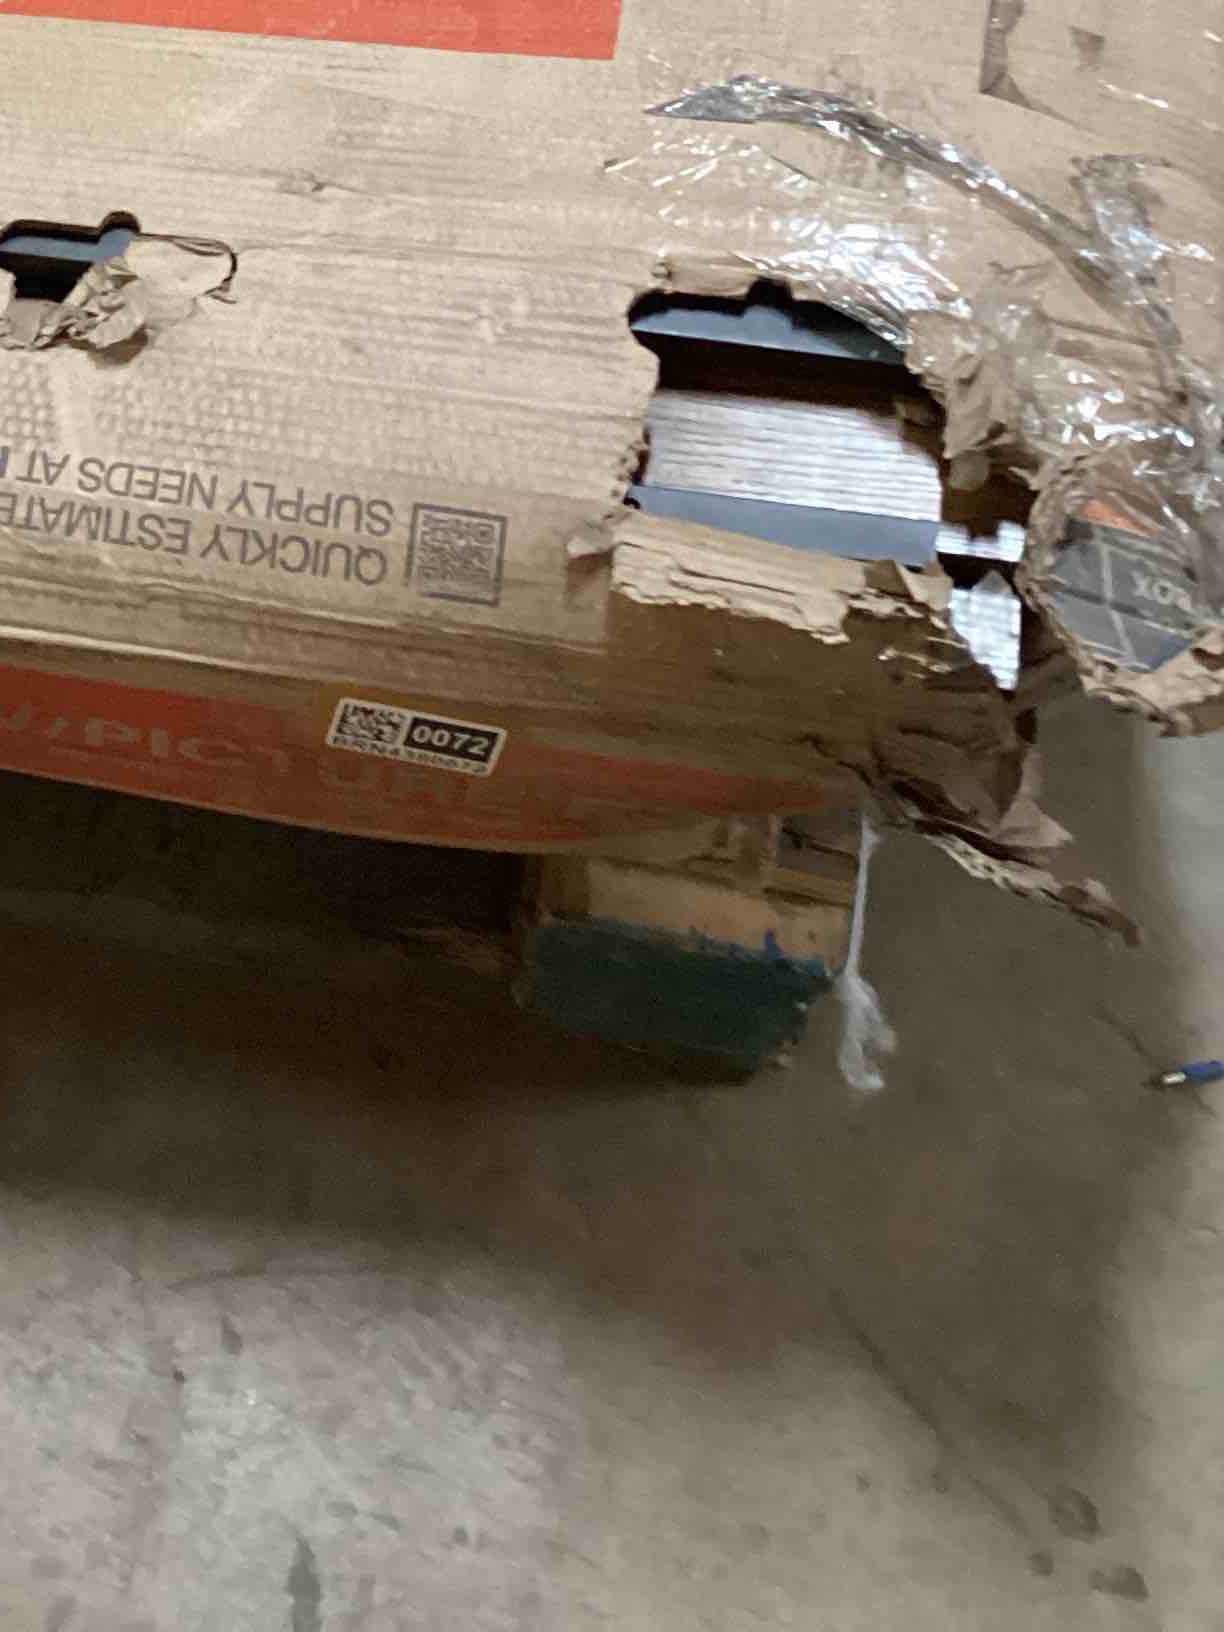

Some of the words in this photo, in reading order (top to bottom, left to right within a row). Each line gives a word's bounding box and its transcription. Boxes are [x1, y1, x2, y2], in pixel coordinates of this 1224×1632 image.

[15, 449, 70, 486] AT
[77, 457, 218, 510] NEEDS
[226, 480, 394, 537] SUPPLY
[200, 523, 387, 585] QUICKLY
[412, 725, 490, 756] 0072
